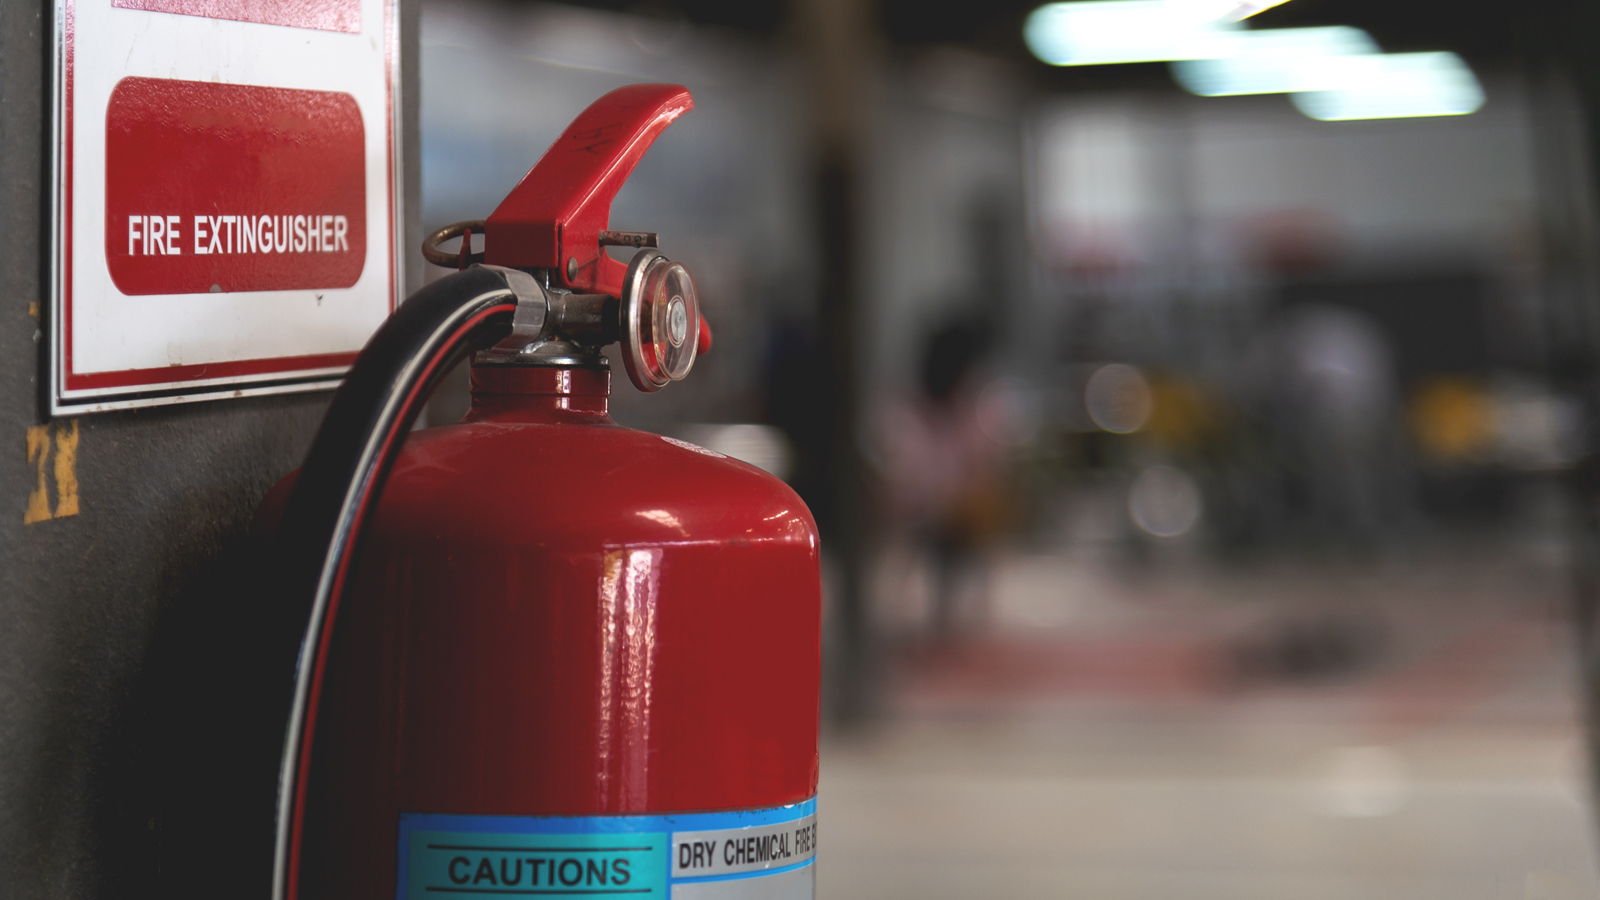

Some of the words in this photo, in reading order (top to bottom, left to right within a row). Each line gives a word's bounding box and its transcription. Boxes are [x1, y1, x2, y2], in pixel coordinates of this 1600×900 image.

[128, 215, 181, 256] FIRE
[194, 214, 349, 255] EXTINGUISHER
[678, 840, 717, 869] DRY
[723, 832, 791, 866] CHEMICAL
[795, 825, 811, 856] FIRE
[448, 856, 631, 887] CAUTIONS
